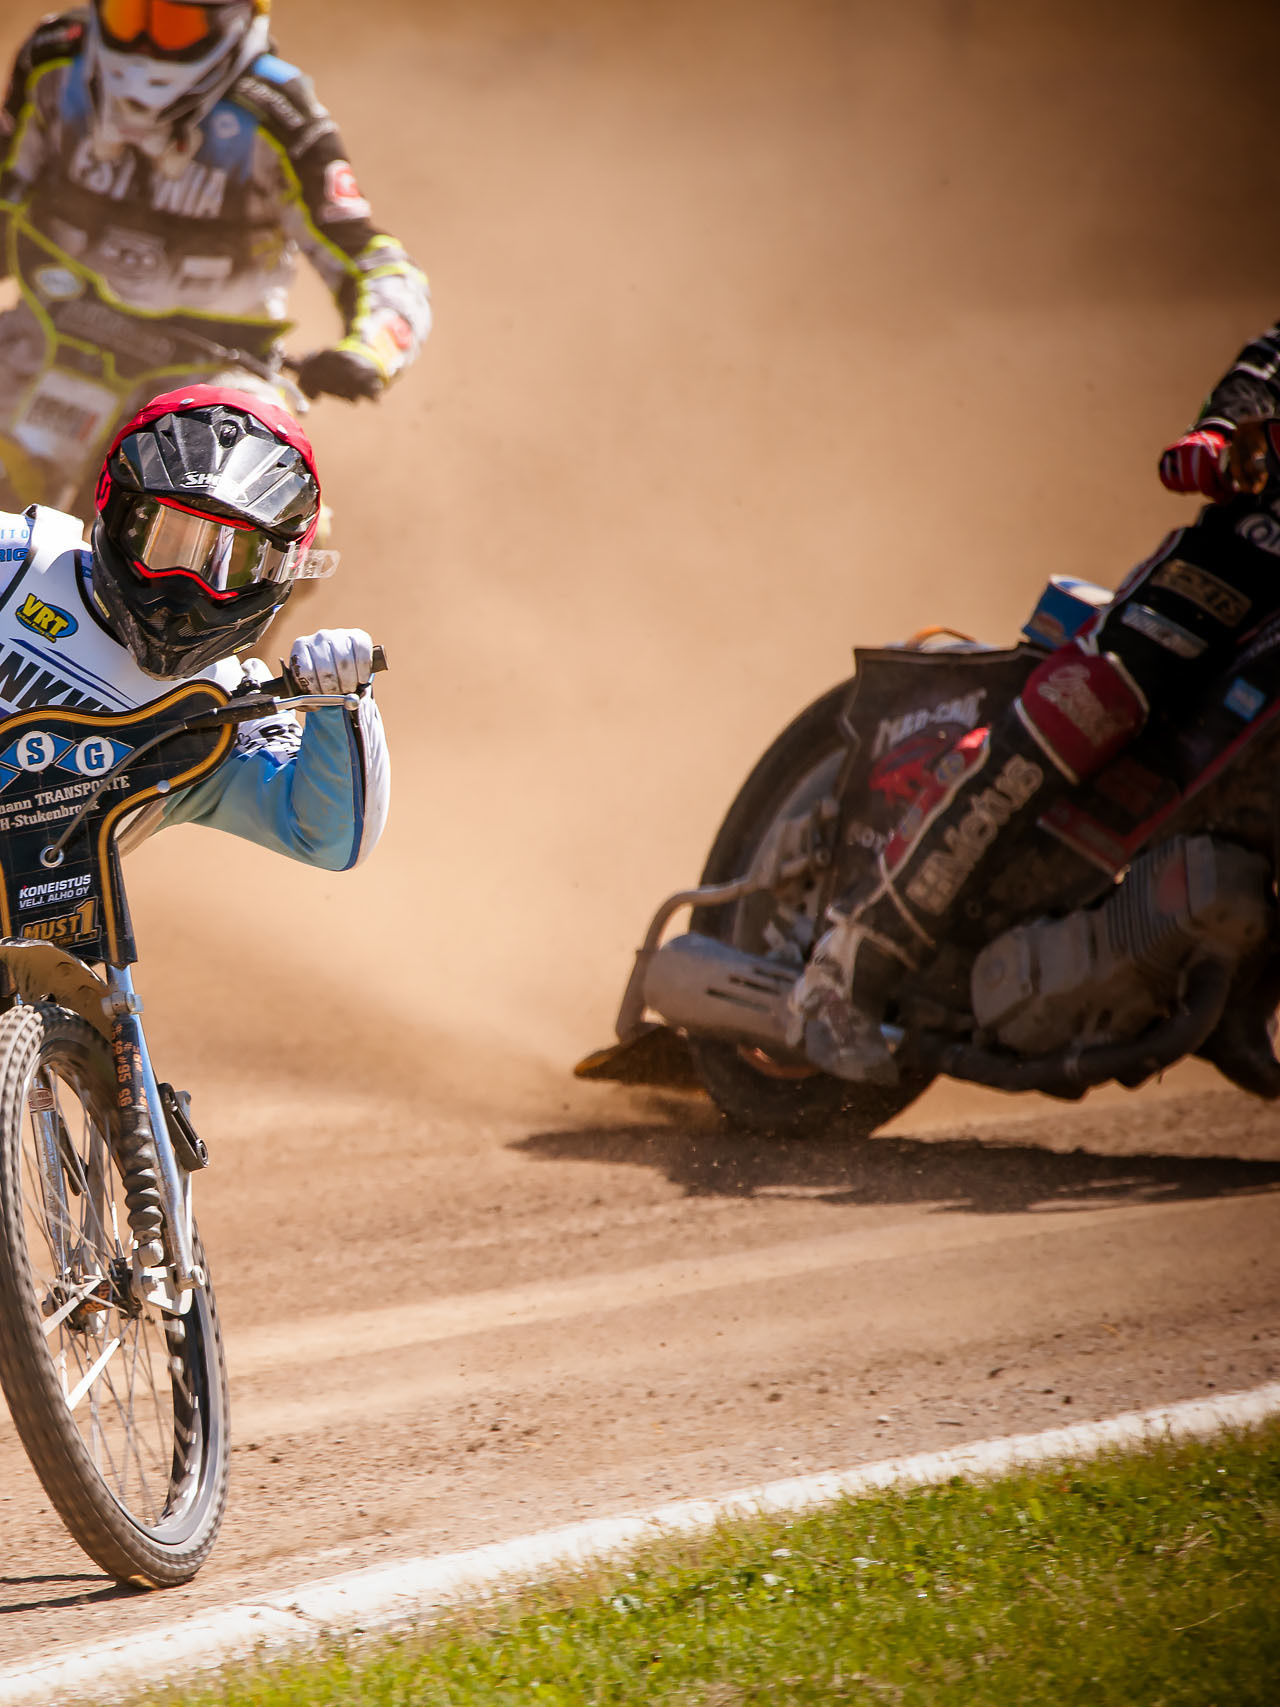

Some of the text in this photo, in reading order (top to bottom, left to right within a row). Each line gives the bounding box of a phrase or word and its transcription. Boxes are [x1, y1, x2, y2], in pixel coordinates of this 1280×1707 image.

[23, 593, 69, 637] VRT
[19, 874, 91, 898] KONEISTUS
[47, 890, 74, 903] ALHO
[75, 885, 90, 897] OY
[22, 914, 81, 941] MUST
